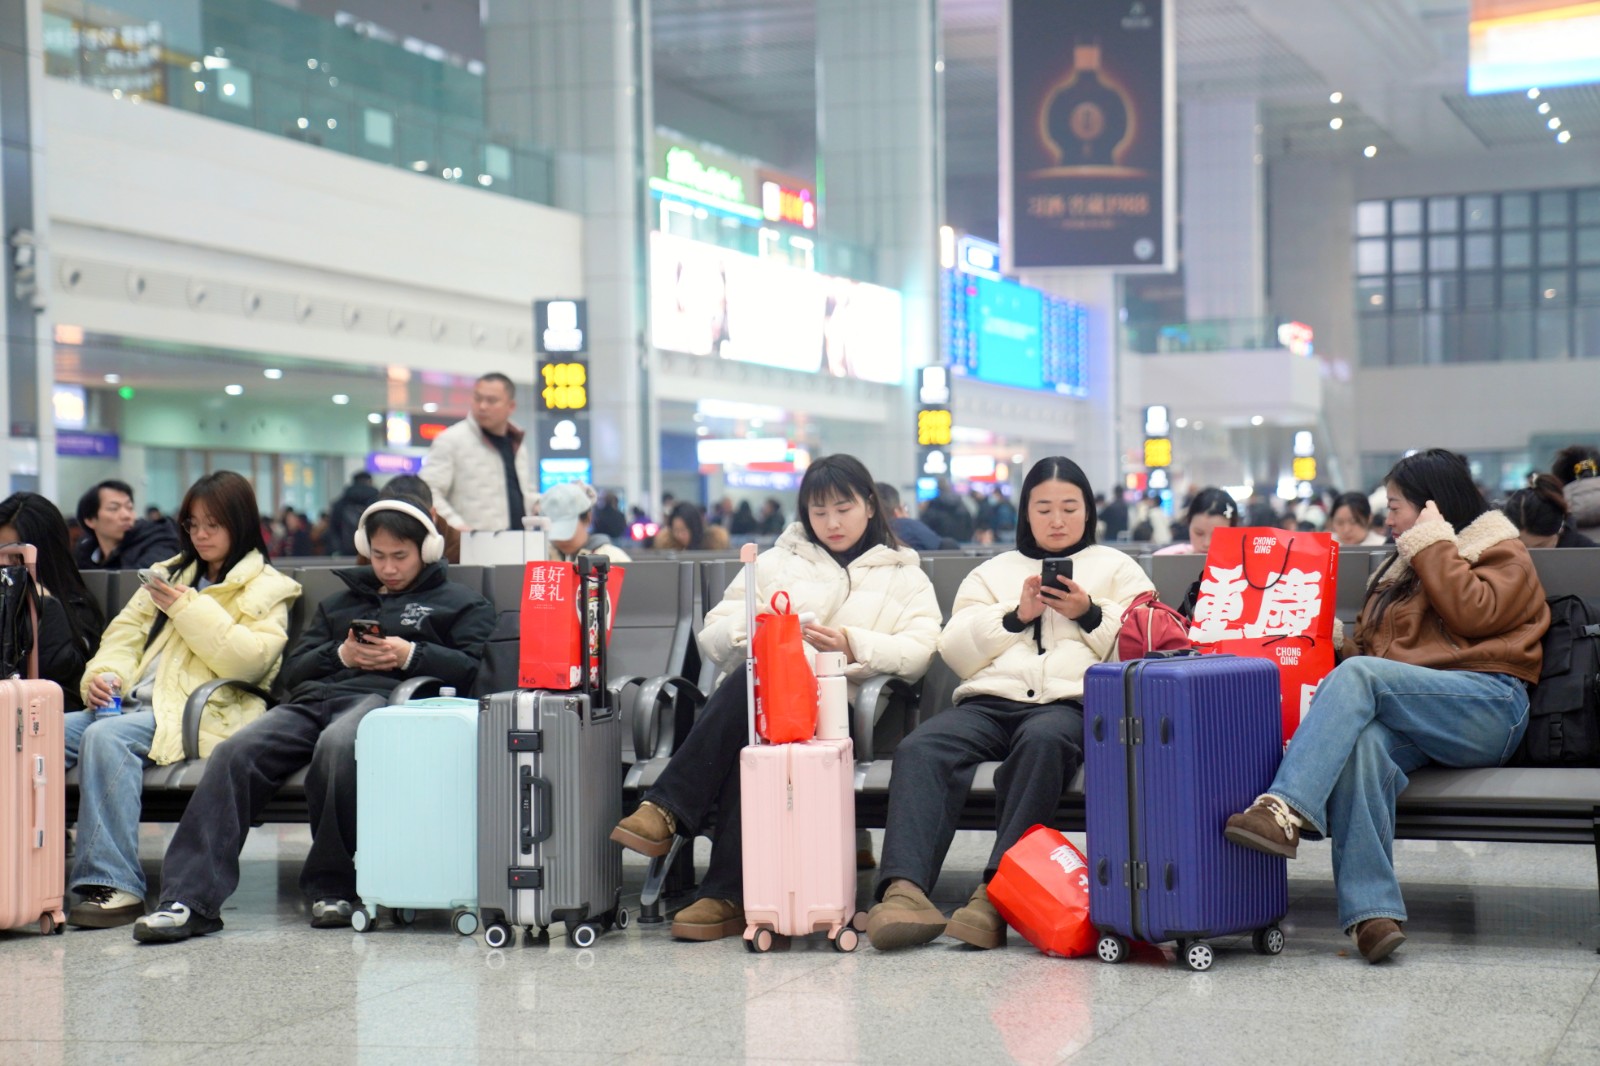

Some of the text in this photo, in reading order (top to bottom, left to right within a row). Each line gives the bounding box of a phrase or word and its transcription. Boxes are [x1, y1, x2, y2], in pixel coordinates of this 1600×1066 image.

[1253, 537, 1276, 546] CHONG
[1254, 546, 1272, 554] QING
[528, 566, 547, 601] 重慶
[547, 566, 565, 601] 好礼
[1276, 647, 1301, 656] CHONG
[1280, 656, 1299, 666] QING
